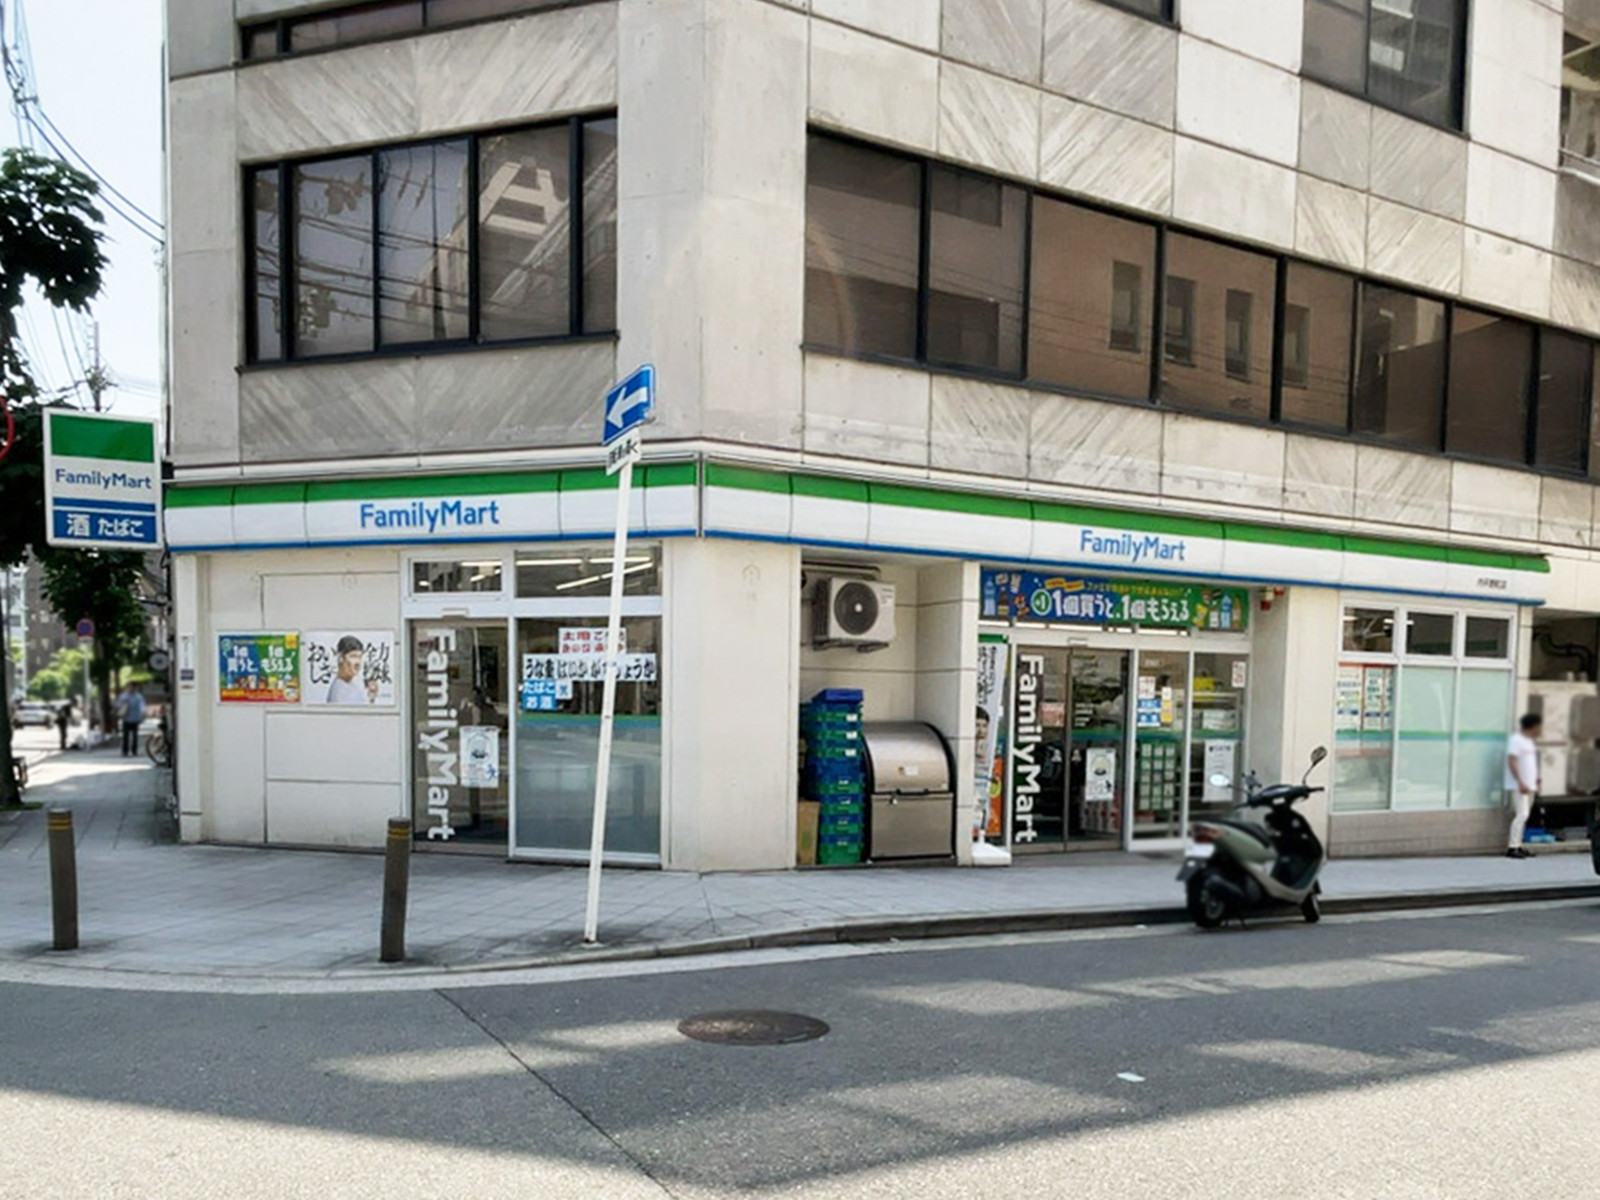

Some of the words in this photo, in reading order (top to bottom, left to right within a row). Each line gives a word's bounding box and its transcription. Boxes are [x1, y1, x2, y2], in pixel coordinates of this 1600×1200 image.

[55, 468, 152, 490] FamilyMart
[67, 513, 91, 537] 酒
[97, 518, 144, 538] たばこ
[360, 500, 499, 533] FamilyMart
[1080, 529, 1186, 563] FamilyMart
[523, 680, 556, 695] たばこ
[418, 629, 459, 840] FamilyMart
[1013, 654, 1044, 843] FamilyMart
